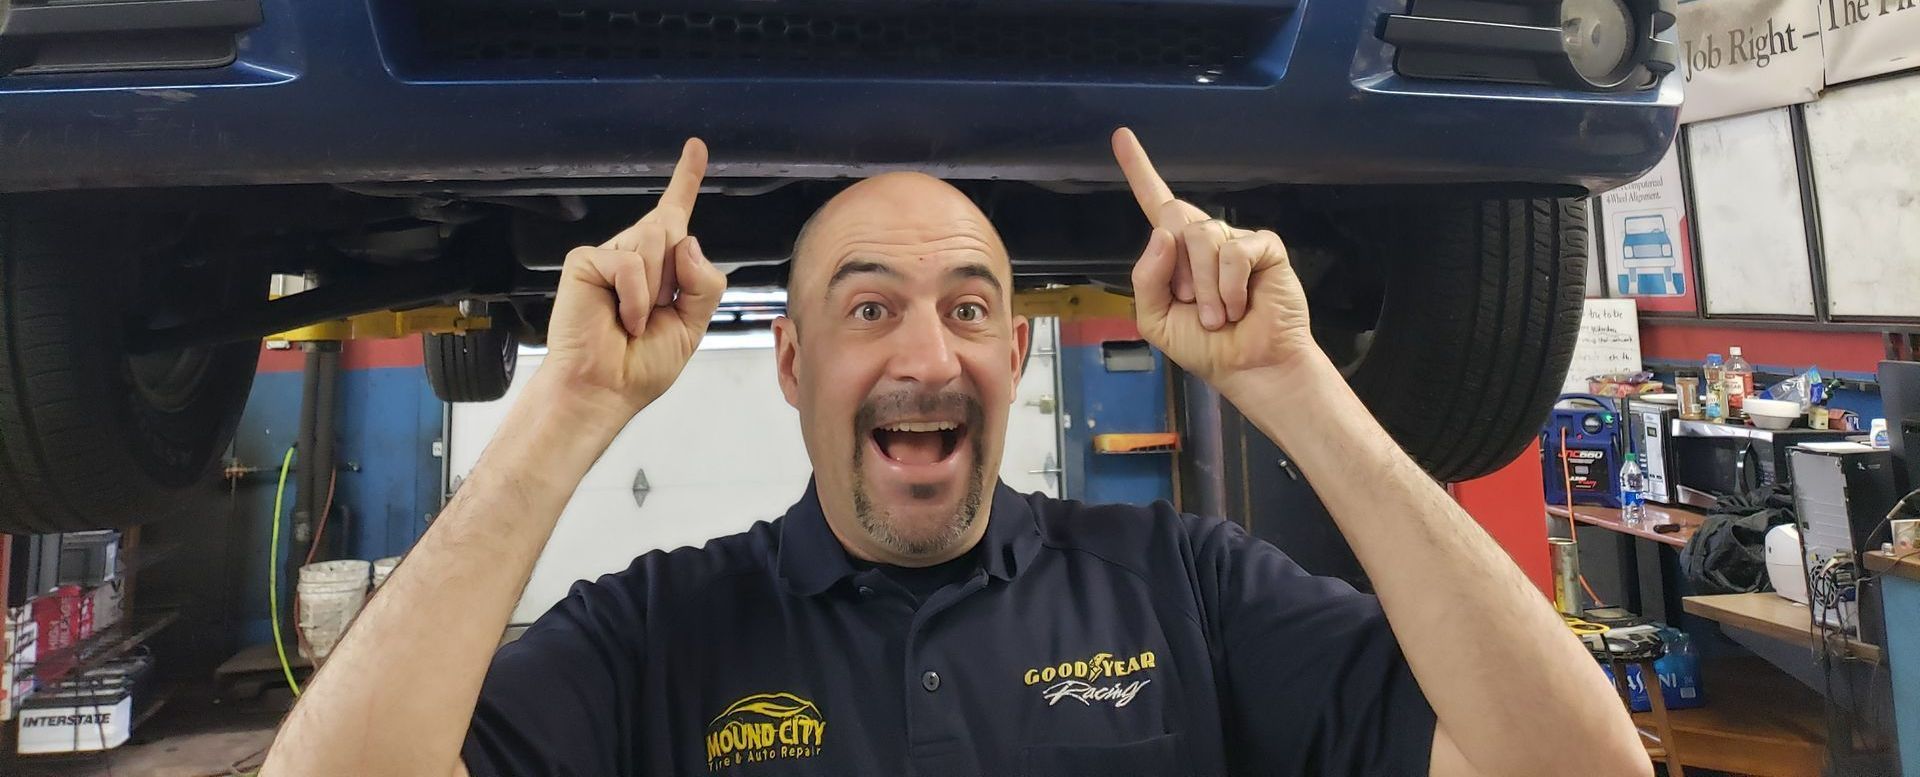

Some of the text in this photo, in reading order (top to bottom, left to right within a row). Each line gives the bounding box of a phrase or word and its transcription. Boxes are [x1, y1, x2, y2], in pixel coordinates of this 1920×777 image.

[1684, 34, 1722, 82] Job
[1728, 18, 1799, 69] Right
[1042, 680, 1151, 708] Racing
[23, 713, 111, 728] INTERSTATE
[706, 718, 826, 762] MOUND CITY
[708, 757, 731, 772] Tire
[748, 749, 776, 763] Auto
[781, 746, 821, 759] Repair
